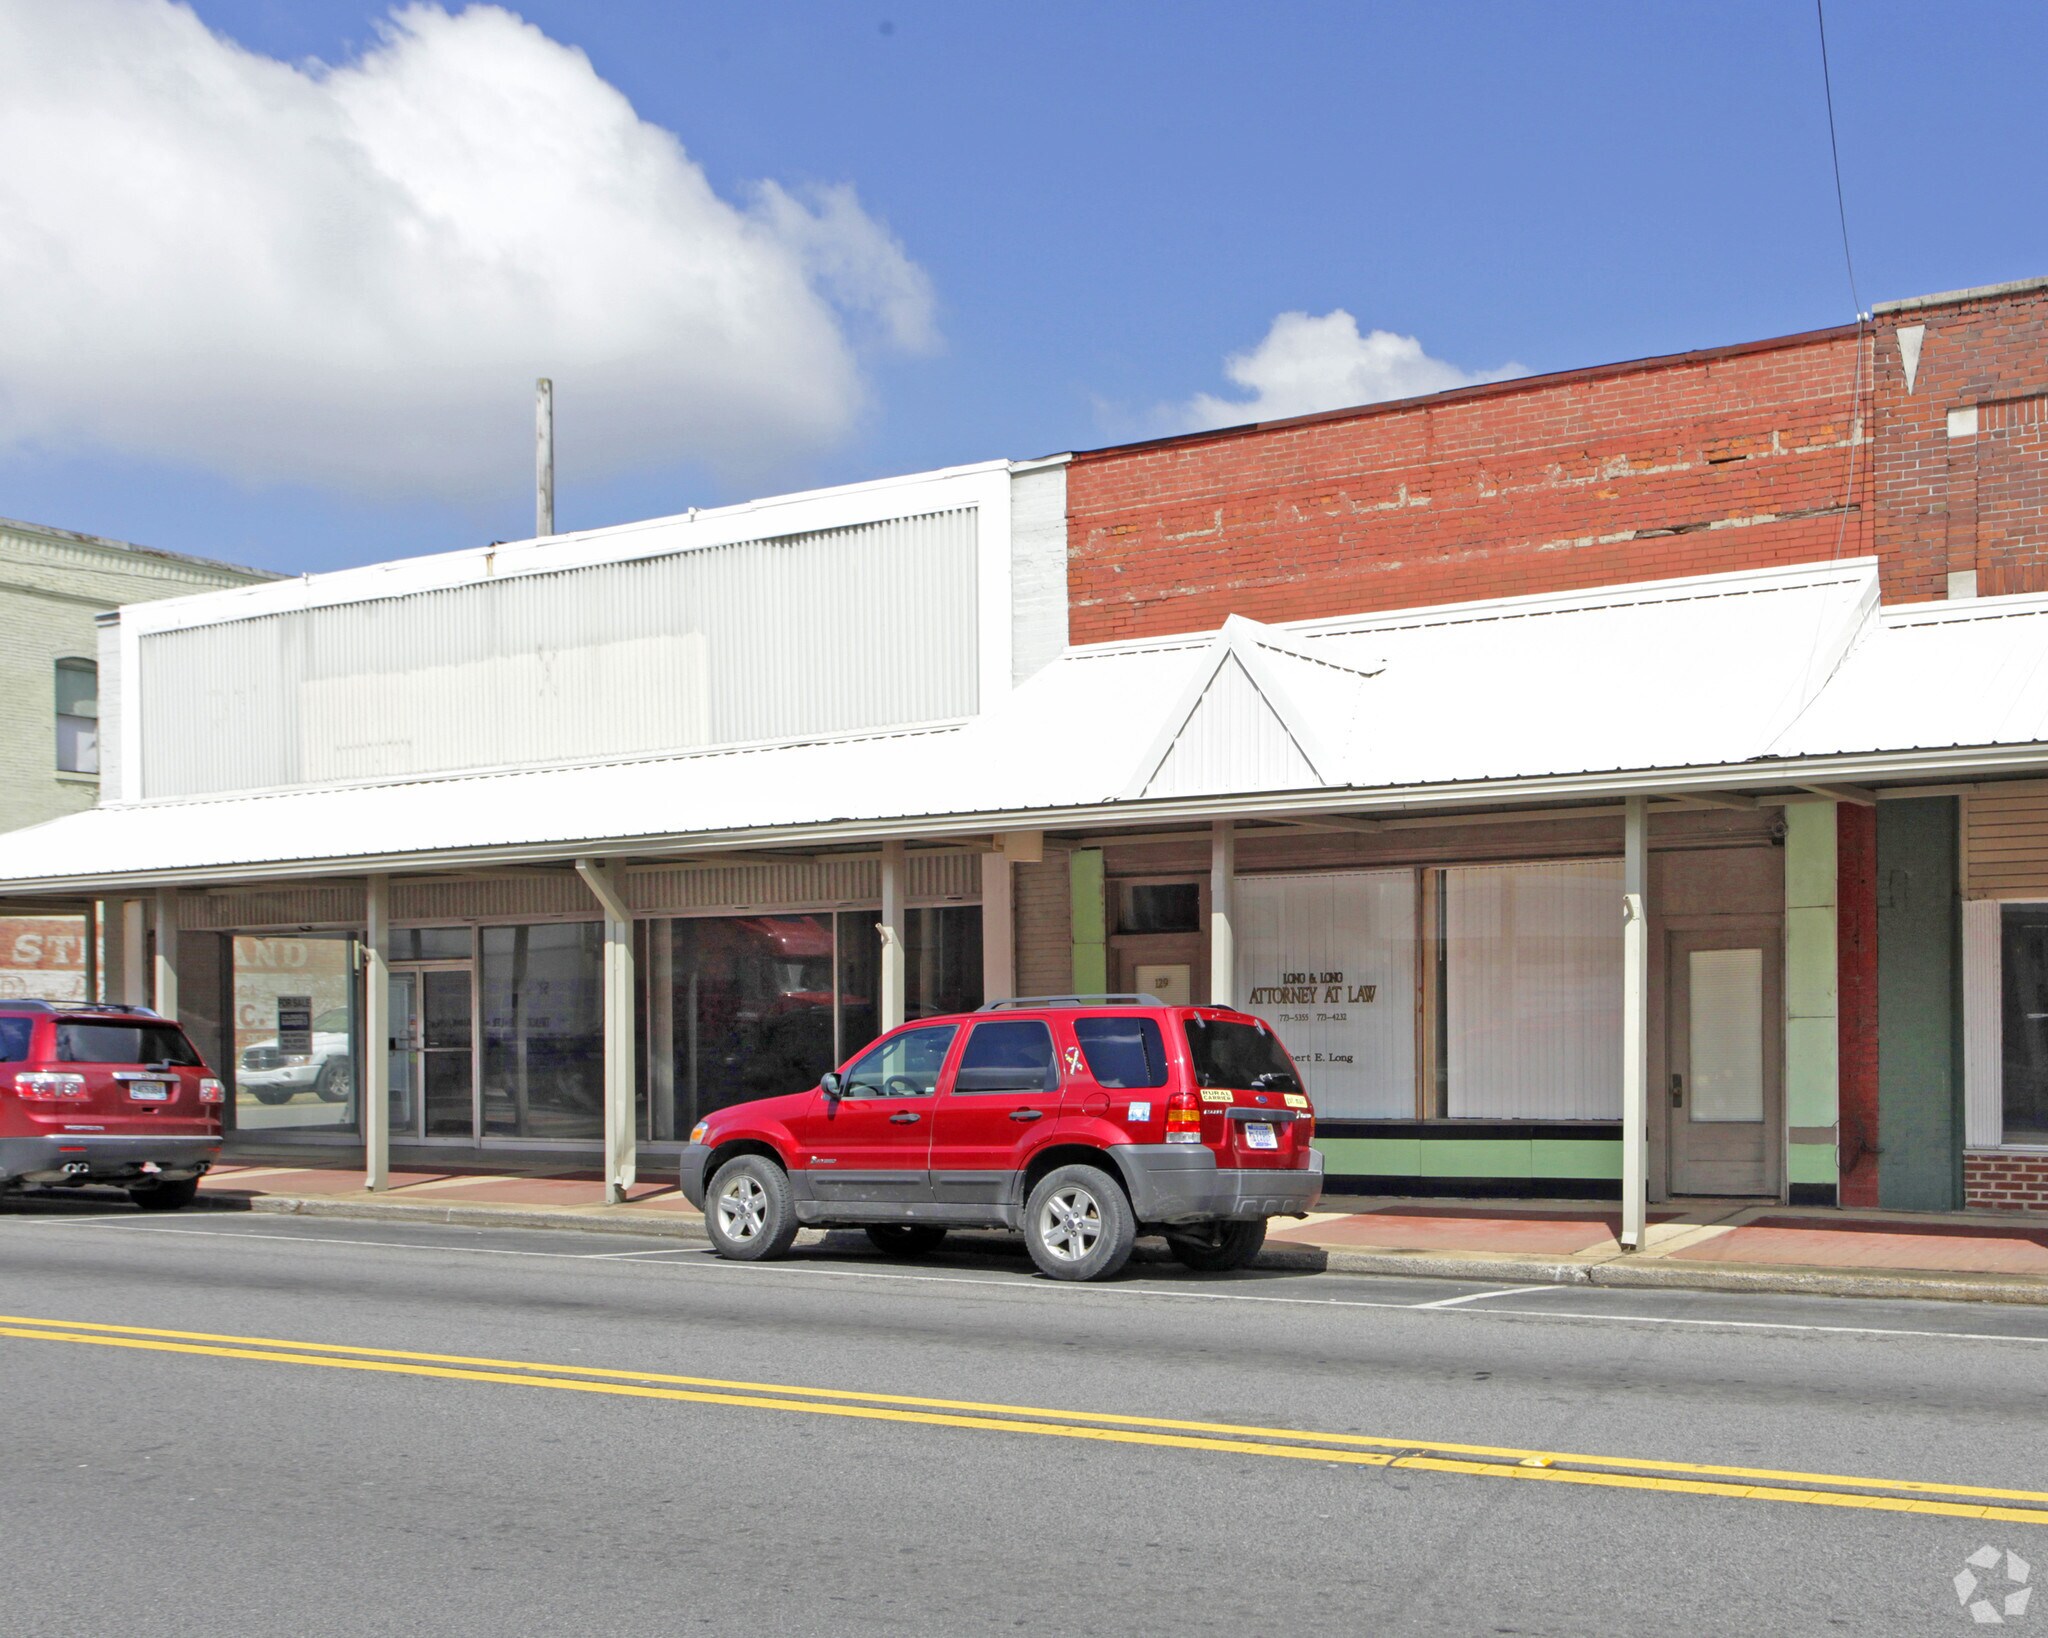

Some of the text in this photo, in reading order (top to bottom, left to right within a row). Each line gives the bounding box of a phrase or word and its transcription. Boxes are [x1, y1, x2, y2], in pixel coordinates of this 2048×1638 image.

[12, 934, 87, 963] ST
[1309, 973, 1318, 984] &
[1249, 985, 1377, 1004] ATTORNEY AT LAW
[1315, 1053, 1326, 1062] E.
[1328, 1053, 1354, 1064] Long
